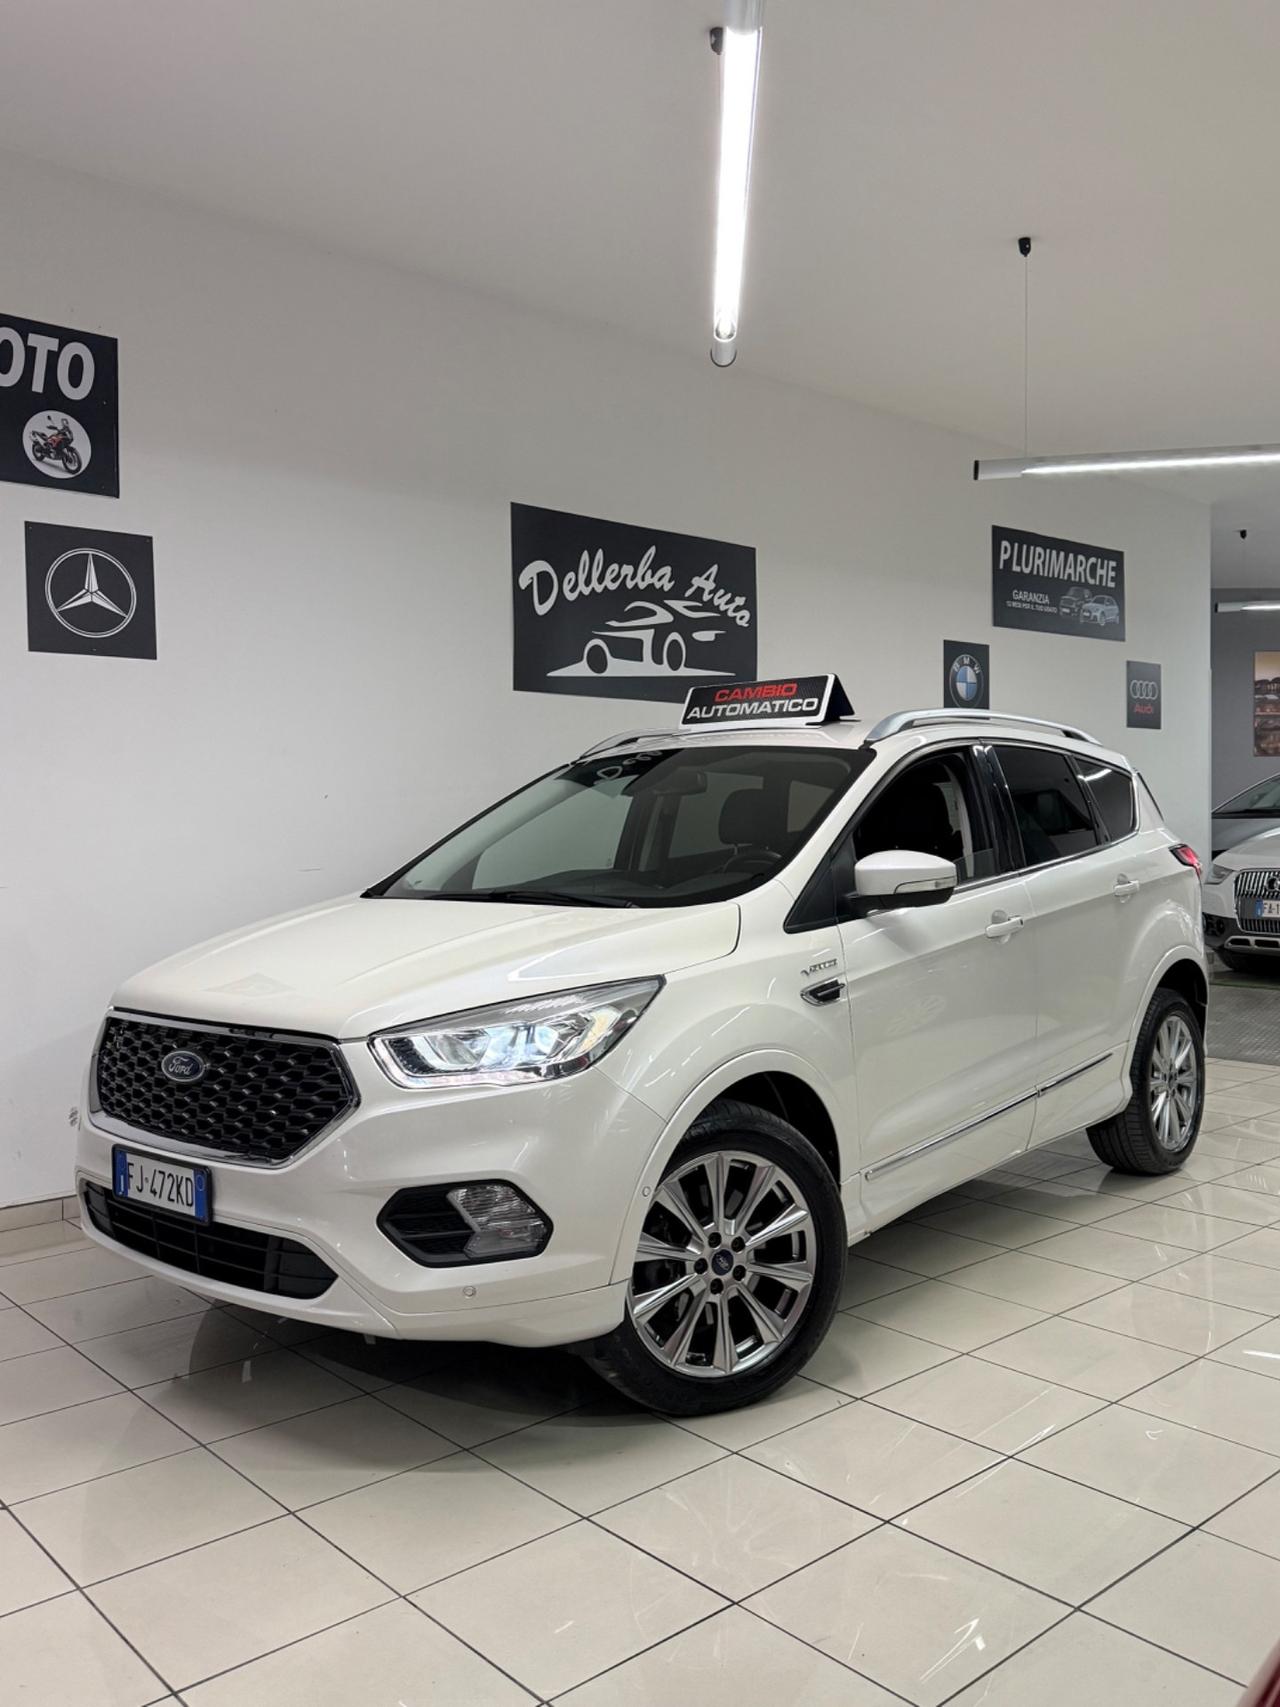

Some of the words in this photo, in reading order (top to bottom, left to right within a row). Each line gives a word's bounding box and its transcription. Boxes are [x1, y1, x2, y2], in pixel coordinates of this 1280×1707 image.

[1000, 540, 1117, 588] PLURIMARCHE
[519, 545, 675, 616] Dellerba
[684, 564, 751, 627] Auto
[1012, 589, 1050, 605] GARANZIA
[952, 656, 981, 673] BMW
[715, 683, 798, 702] CAMBIO
[687, 698, 819, 719] AUTOMATICO
[1133, 703, 1154, 714] Audi
[168, 1056, 194, 1076] Ford
